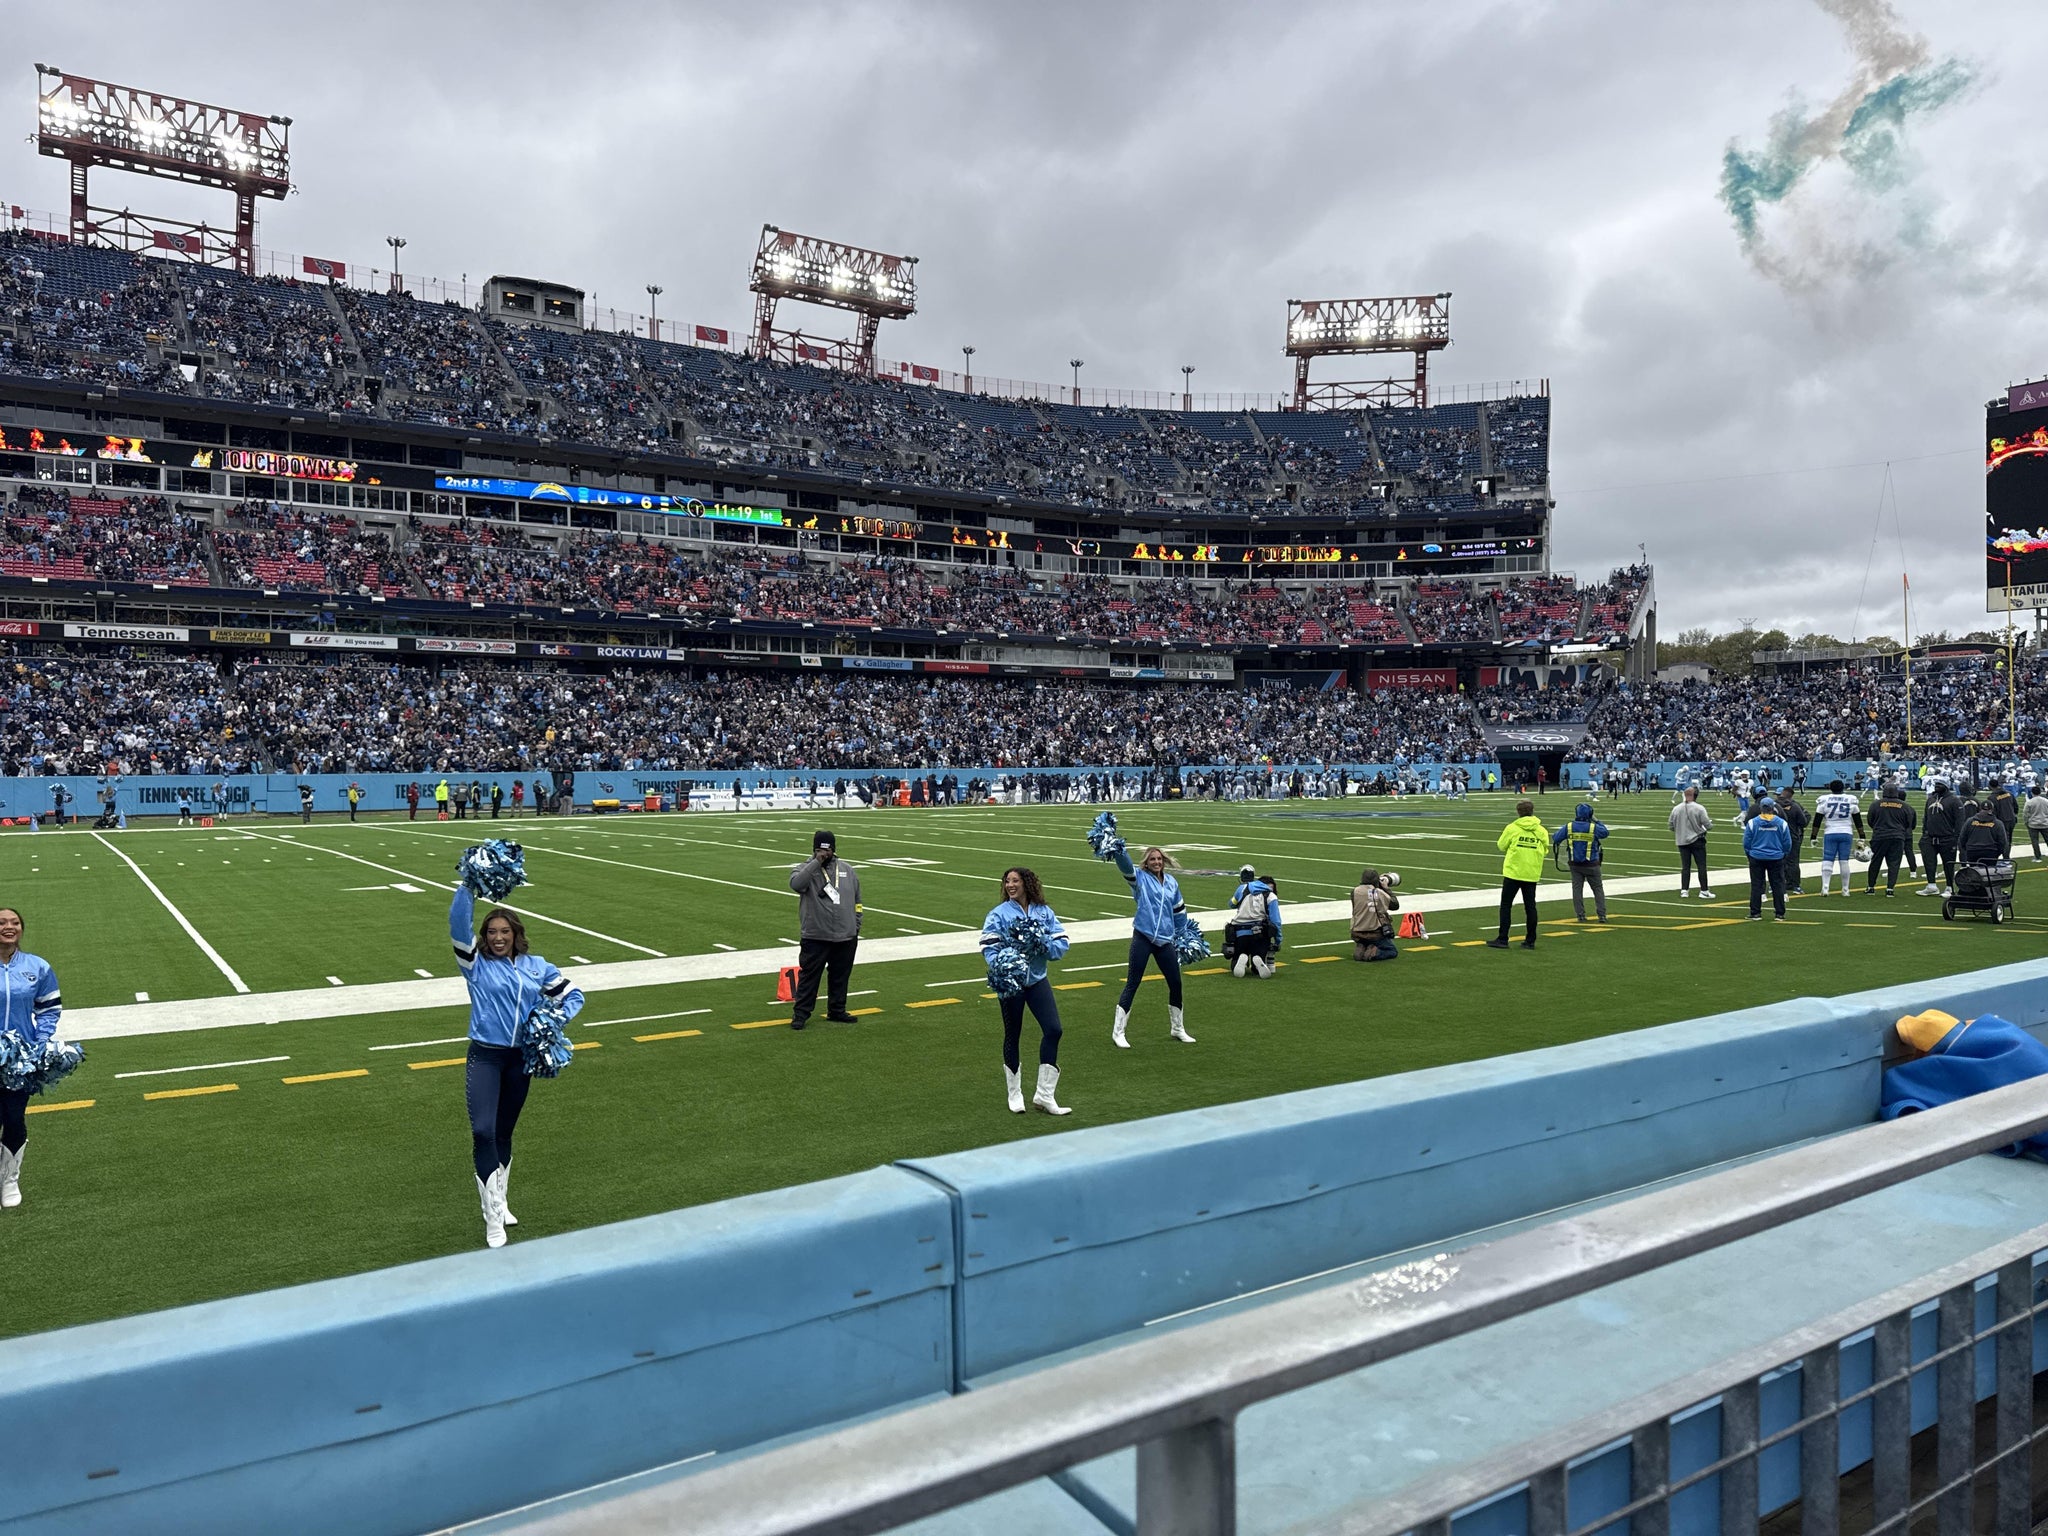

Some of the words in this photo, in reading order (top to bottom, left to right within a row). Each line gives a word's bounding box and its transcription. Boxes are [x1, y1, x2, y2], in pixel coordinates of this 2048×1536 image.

[445, 476, 469, 488] 2nd
[471, 478, 480, 489] &
[482, 479, 490, 490] 5
[641, 496, 652, 509] 6
[714, 503, 752, 519] 11:19
[759, 510, 773, 520] 1st
[1258, 546, 1327, 561] TOUCHDOWN
[2002, 585, 2035, 597] TITAN
[2032, 597, 2047, 606] Lite
[540, 644, 571, 656] FedEx
[597, 647, 636, 658] ROCKY
[638, 648, 662, 659] LAW
[866, 659, 903, 669] Gallagher
[1379, 674, 1445, 684] NISSAN
[638, 780, 680, 794] TENNESS
[210, 786, 249, 802] UGH
[1827, 802, 1850, 819] 79
[203, 818, 212, 827] 10
[1518, 836, 1540, 844] BEST
